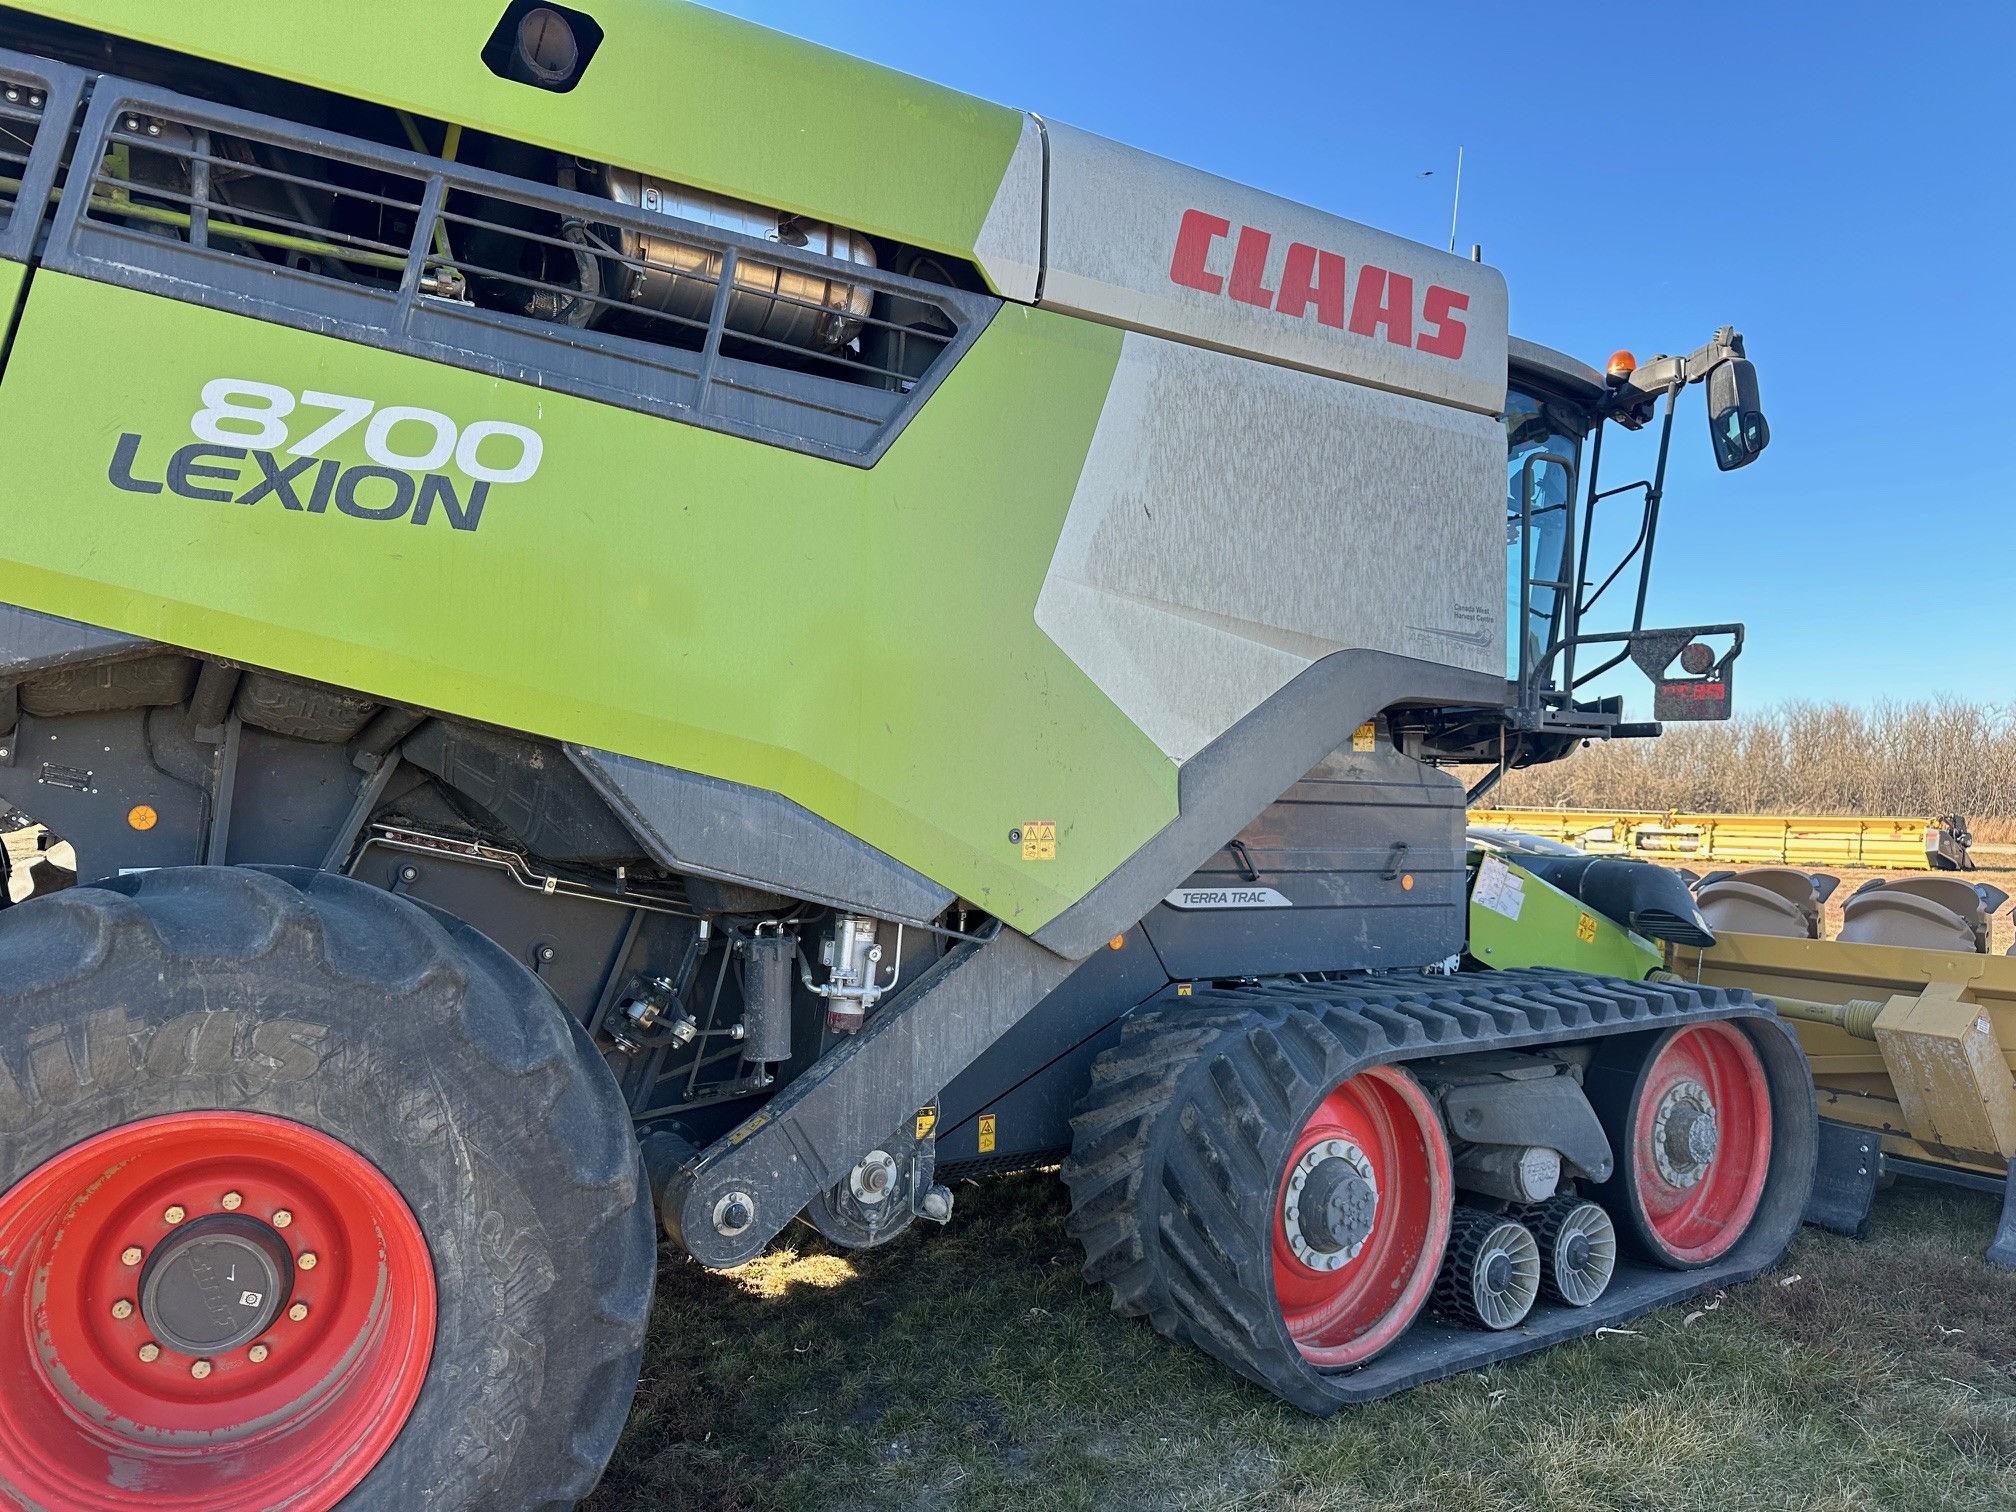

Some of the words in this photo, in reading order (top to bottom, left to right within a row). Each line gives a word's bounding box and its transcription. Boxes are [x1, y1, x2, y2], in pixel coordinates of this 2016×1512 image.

[1170, 208, 1470, 360] CLAAS
[191, 377, 543, 485] 8700
[107, 432, 491, 532] LEXION
[1453, 603, 1475, 613] Canada
[1475, 605, 1490, 615] West
[1453, 611, 1475, 622] Harvest
[1475, 614, 1495, 623] Centre
[1183, 892, 1228, 904] TERRA
[1231, 891, 1267, 903] TRAC
